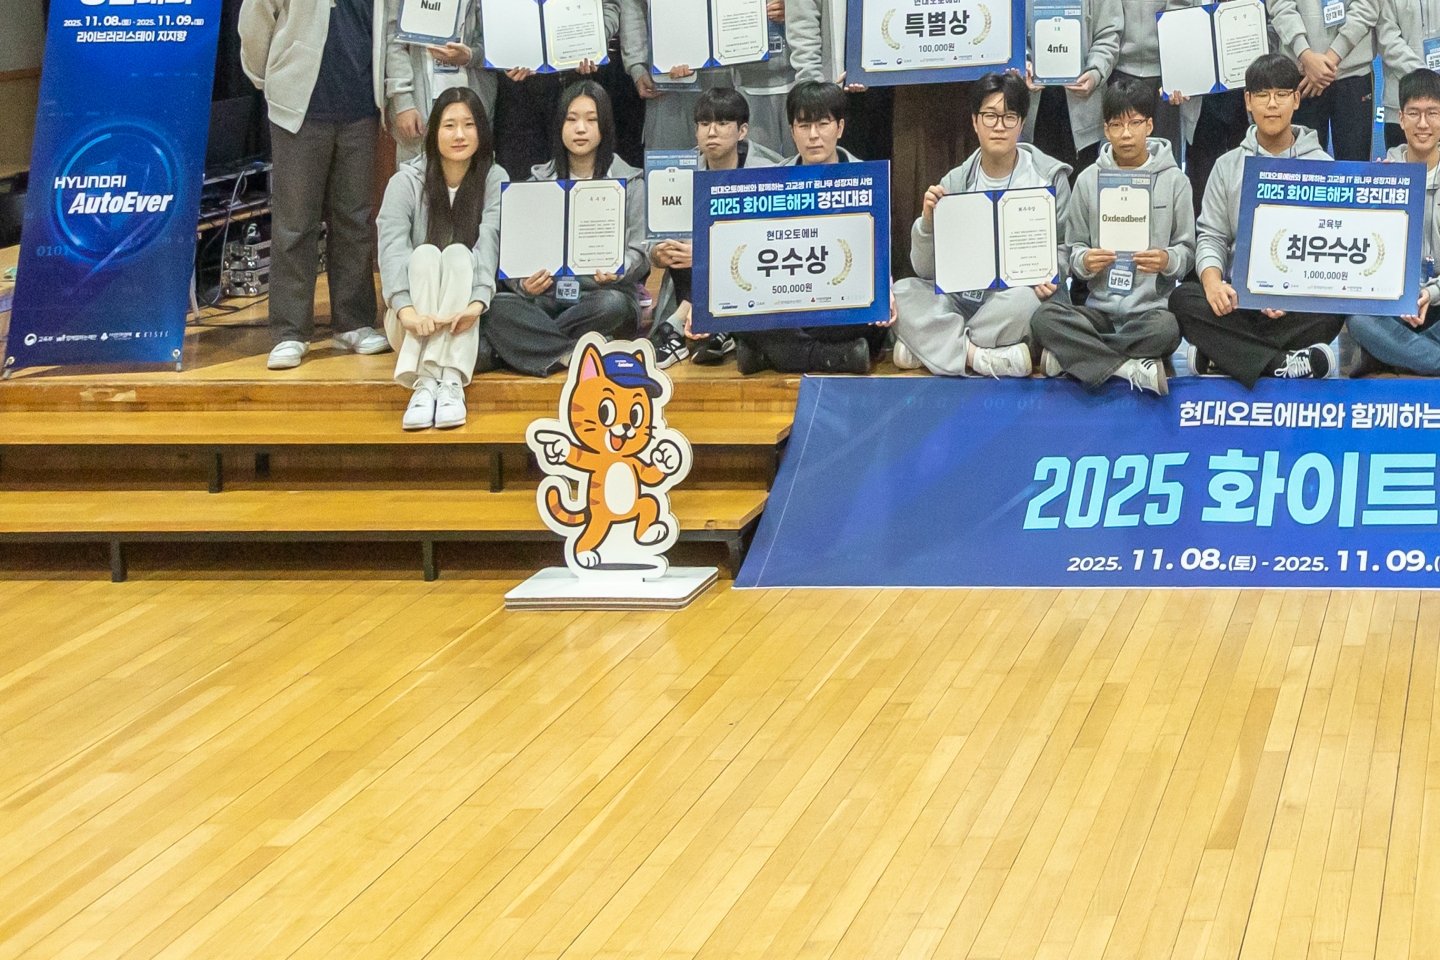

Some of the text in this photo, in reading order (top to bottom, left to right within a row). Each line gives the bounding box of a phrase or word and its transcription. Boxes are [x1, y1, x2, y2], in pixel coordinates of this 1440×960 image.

[420, 0, 441, 11] Null
[905, 10, 970, 37] 특별상
[77, 31, 187, 42] 라이브러리스테이 지지향
[919, 43, 955, 52] 100,000원
[1047, 44, 1068, 53] 4nfu
[54, 175, 126, 189] HYUNDAI
[1257, 183, 1409, 204] 2025 화이트해커 경진대회
[68, 192, 173, 214] AutoEver
[662, 196, 682, 206] HAK
[710, 189, 872, 215] 2025 화이트해커 경진대회
[1318, 219, 1342, 229] 교육부
[767, 228, 818, 241] 현대오토에버
[1286, 234, 1370, 264] 최우수상
[757, 246, 828, 277] 우수상
[1304, 271, 1348, 280] 1,000,000원
[772, 283, 812, 294] 500,000원
[1179, 400, 1346, 429] 현대오토에버와
[1023, 452, 1190, 530] 2025
[1066, 556, 1122, 572] 2025.
[1132, 548, 1173, 571] 11.
[1273, 556, 1329, 572] 2025.
[1337, 550, 1379, 572] 11.
